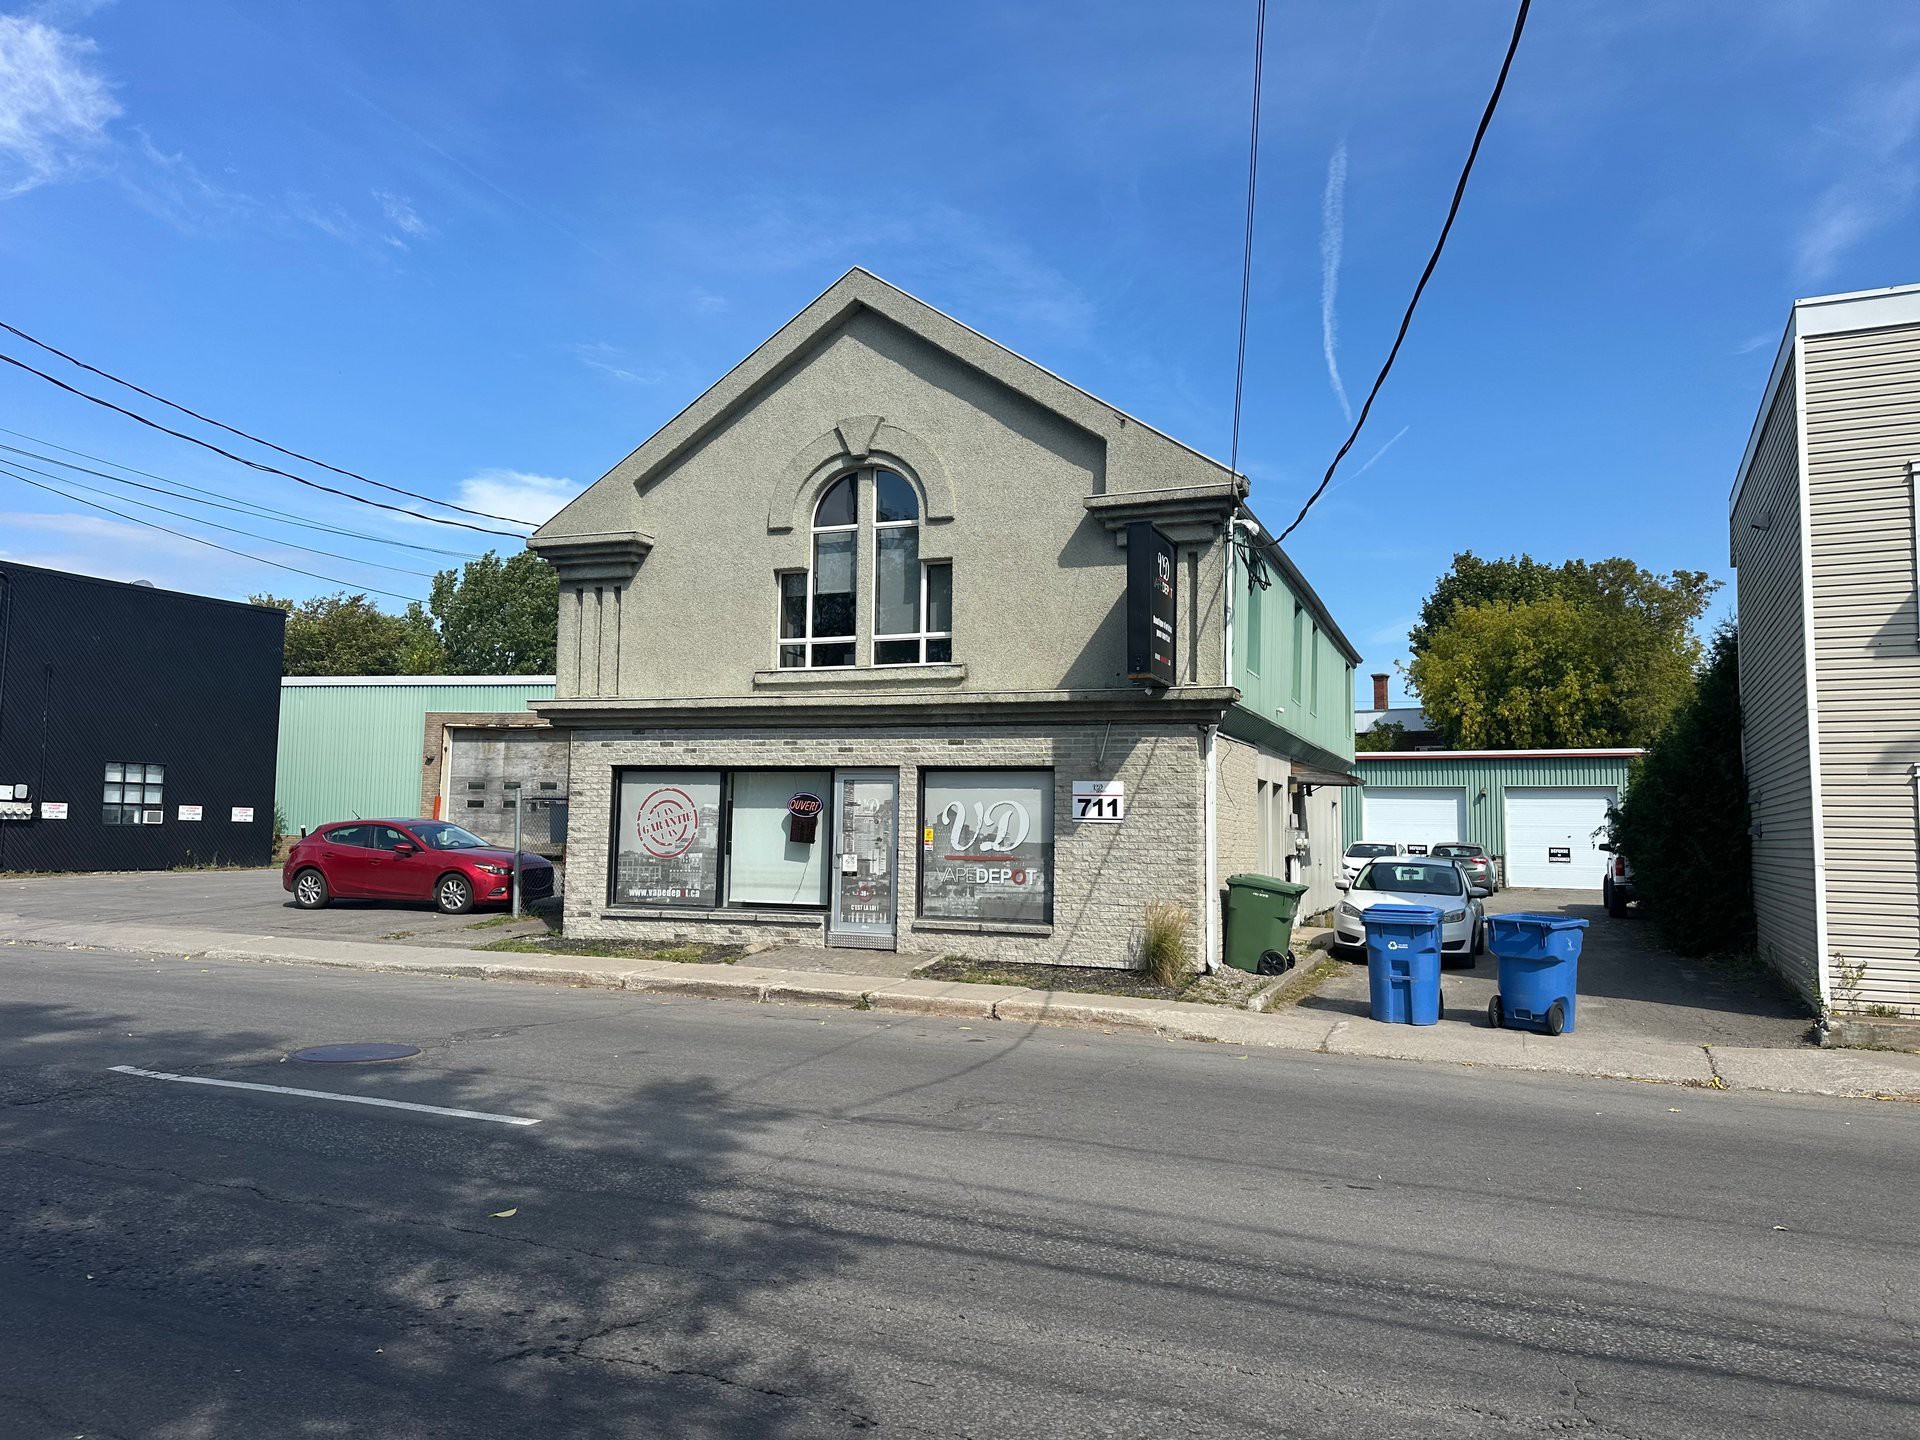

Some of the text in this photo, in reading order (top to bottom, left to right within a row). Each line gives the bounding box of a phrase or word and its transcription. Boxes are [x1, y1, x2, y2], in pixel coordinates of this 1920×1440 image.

[789, 799, 820, 812] OUVERT
[1077, 798, 1118, 817] 711
[642, 811, 693, 835] GARANTIE
[628, 888, 701, 899] www.vapedepot.ca
